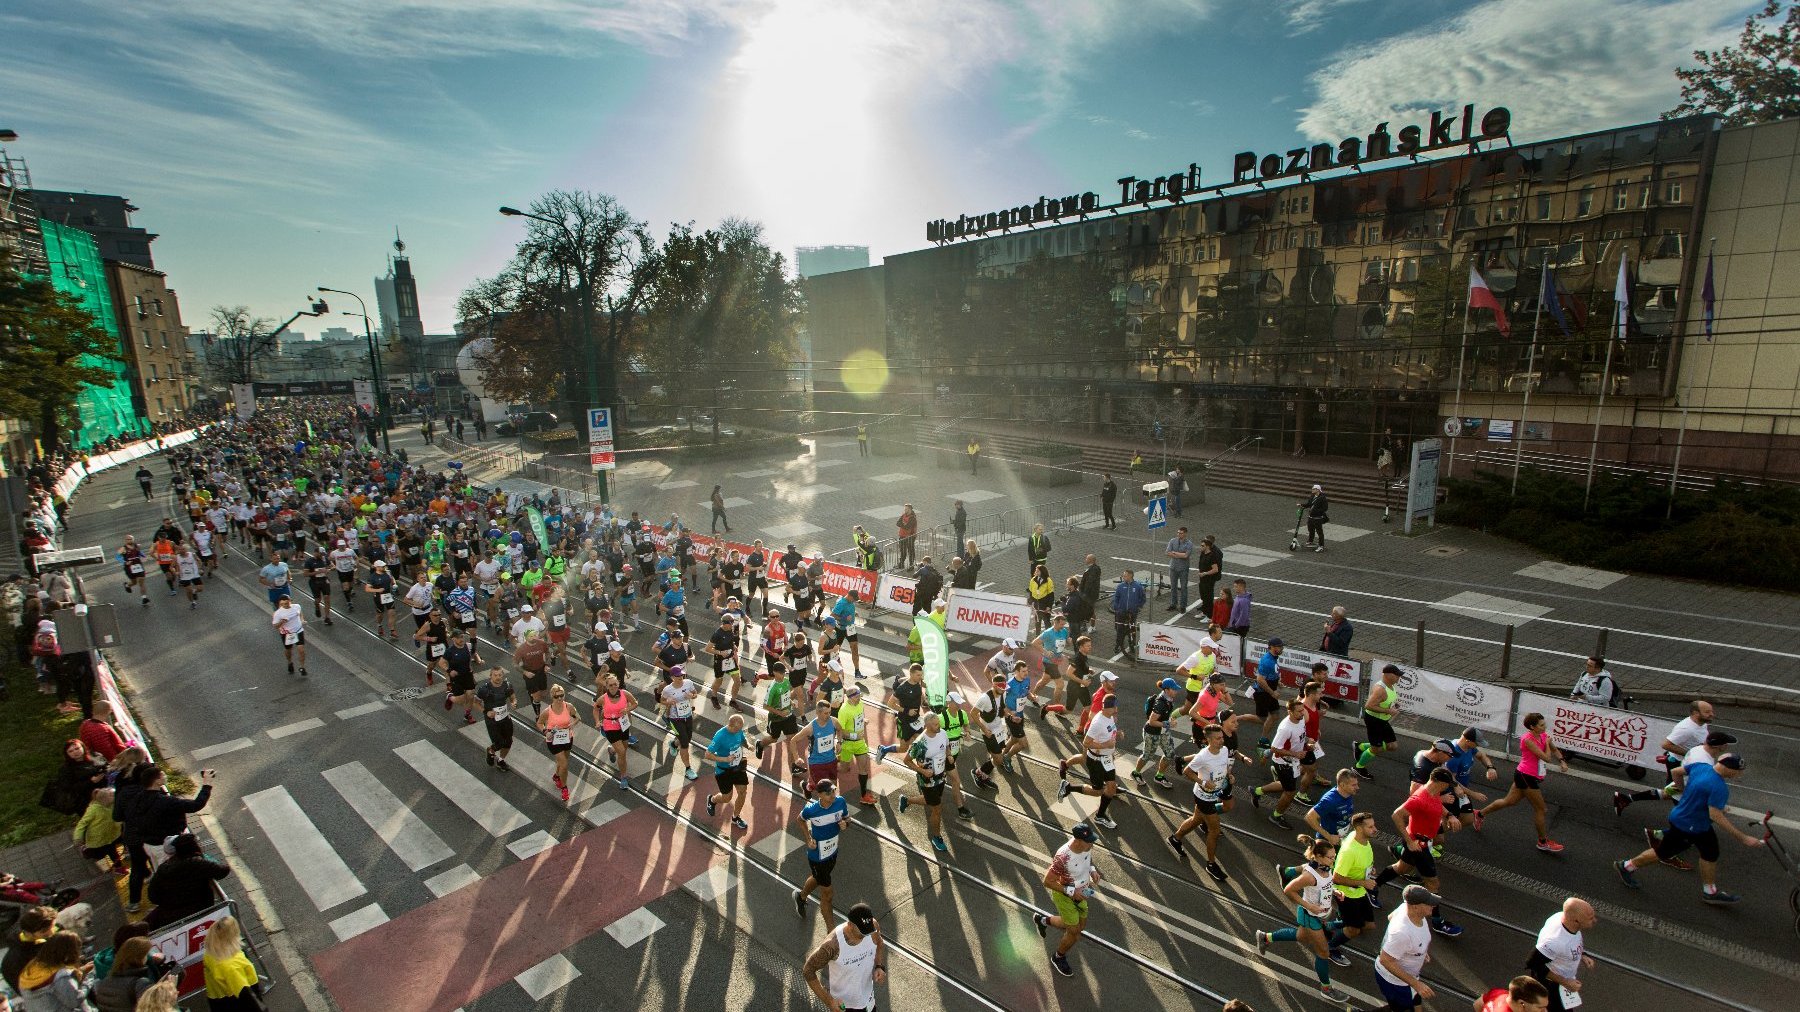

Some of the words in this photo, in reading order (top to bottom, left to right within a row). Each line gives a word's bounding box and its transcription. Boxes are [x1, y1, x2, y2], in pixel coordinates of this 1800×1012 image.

[1117, 162, 1200, 203] Targi
[1234, 103, 1511, 183] Poznańskie
[823, 569, 872, 595] terravita
[1145, 643, 1180, 653] MARATONY
[1145, 648, 1180, 659] POLSKIE.PL
[1446, 704, 1491, 720] Sheraton
[1555, 707, 1631, 733] DRUŻYNA
[1553, 719, 1648, 751] SZPIKU
